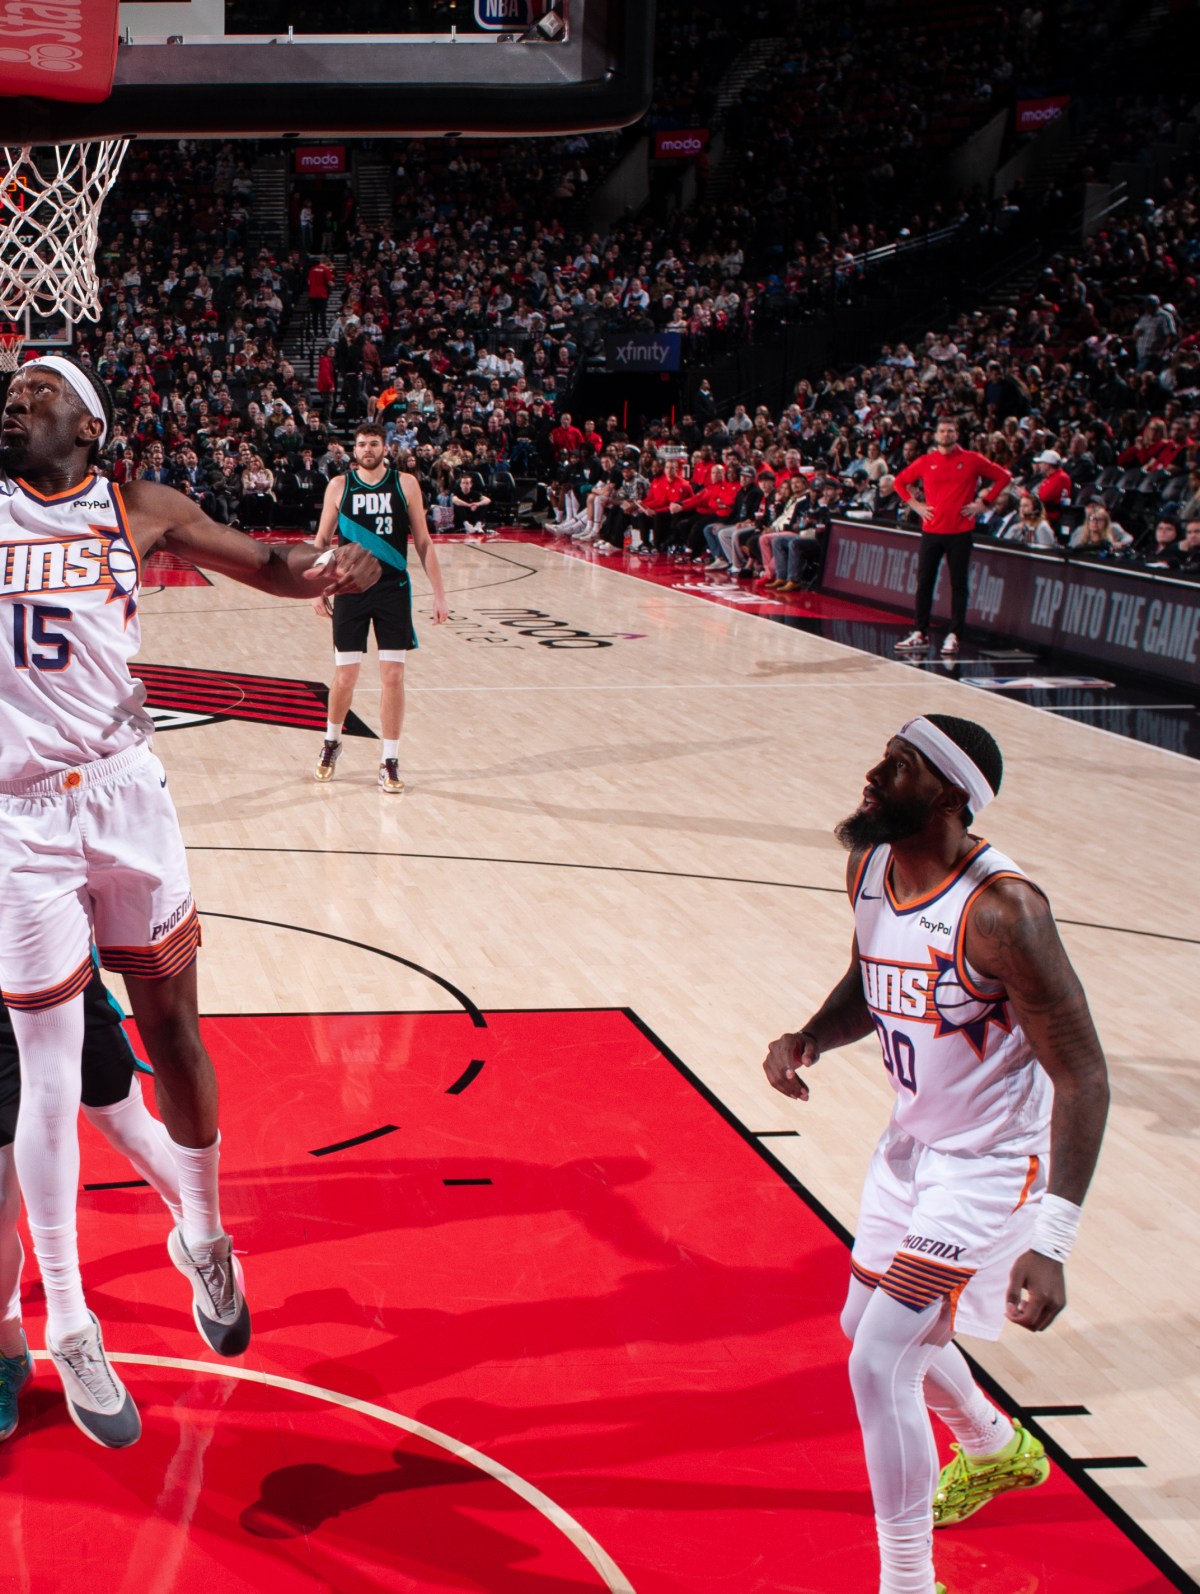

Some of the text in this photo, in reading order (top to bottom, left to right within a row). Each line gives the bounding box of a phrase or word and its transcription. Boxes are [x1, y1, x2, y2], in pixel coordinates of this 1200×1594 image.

[301, 153, 339, 165] moda
[661, 137, 702, 150] moda
[616, 340, 670, 364] xfinity
[73, 499, 110, 510] PayPal
[352, 492, 393, 515] PDX
[375, 516, 393, 535] 23
[835, 538, 857, 579] TAP
[854, 544, 884, 587] INTO
[883, 548, 909, 594] THE
[976, 564, 1004, 623] App
[473, 608, 618, 650] moda
[1031, 576, 1064, 628] TAP
[1061, 583, 1107, 640] INTO
[1106, 591, 1146, 649] THE
[1143, 599, 1200, 664] GAME
[12, 603, 73, 673] 15
[152, 891, 192, 941] PHOENI
[919, 916, 952, 936] PayPal
[860, 960, 929, 1018] UNS
